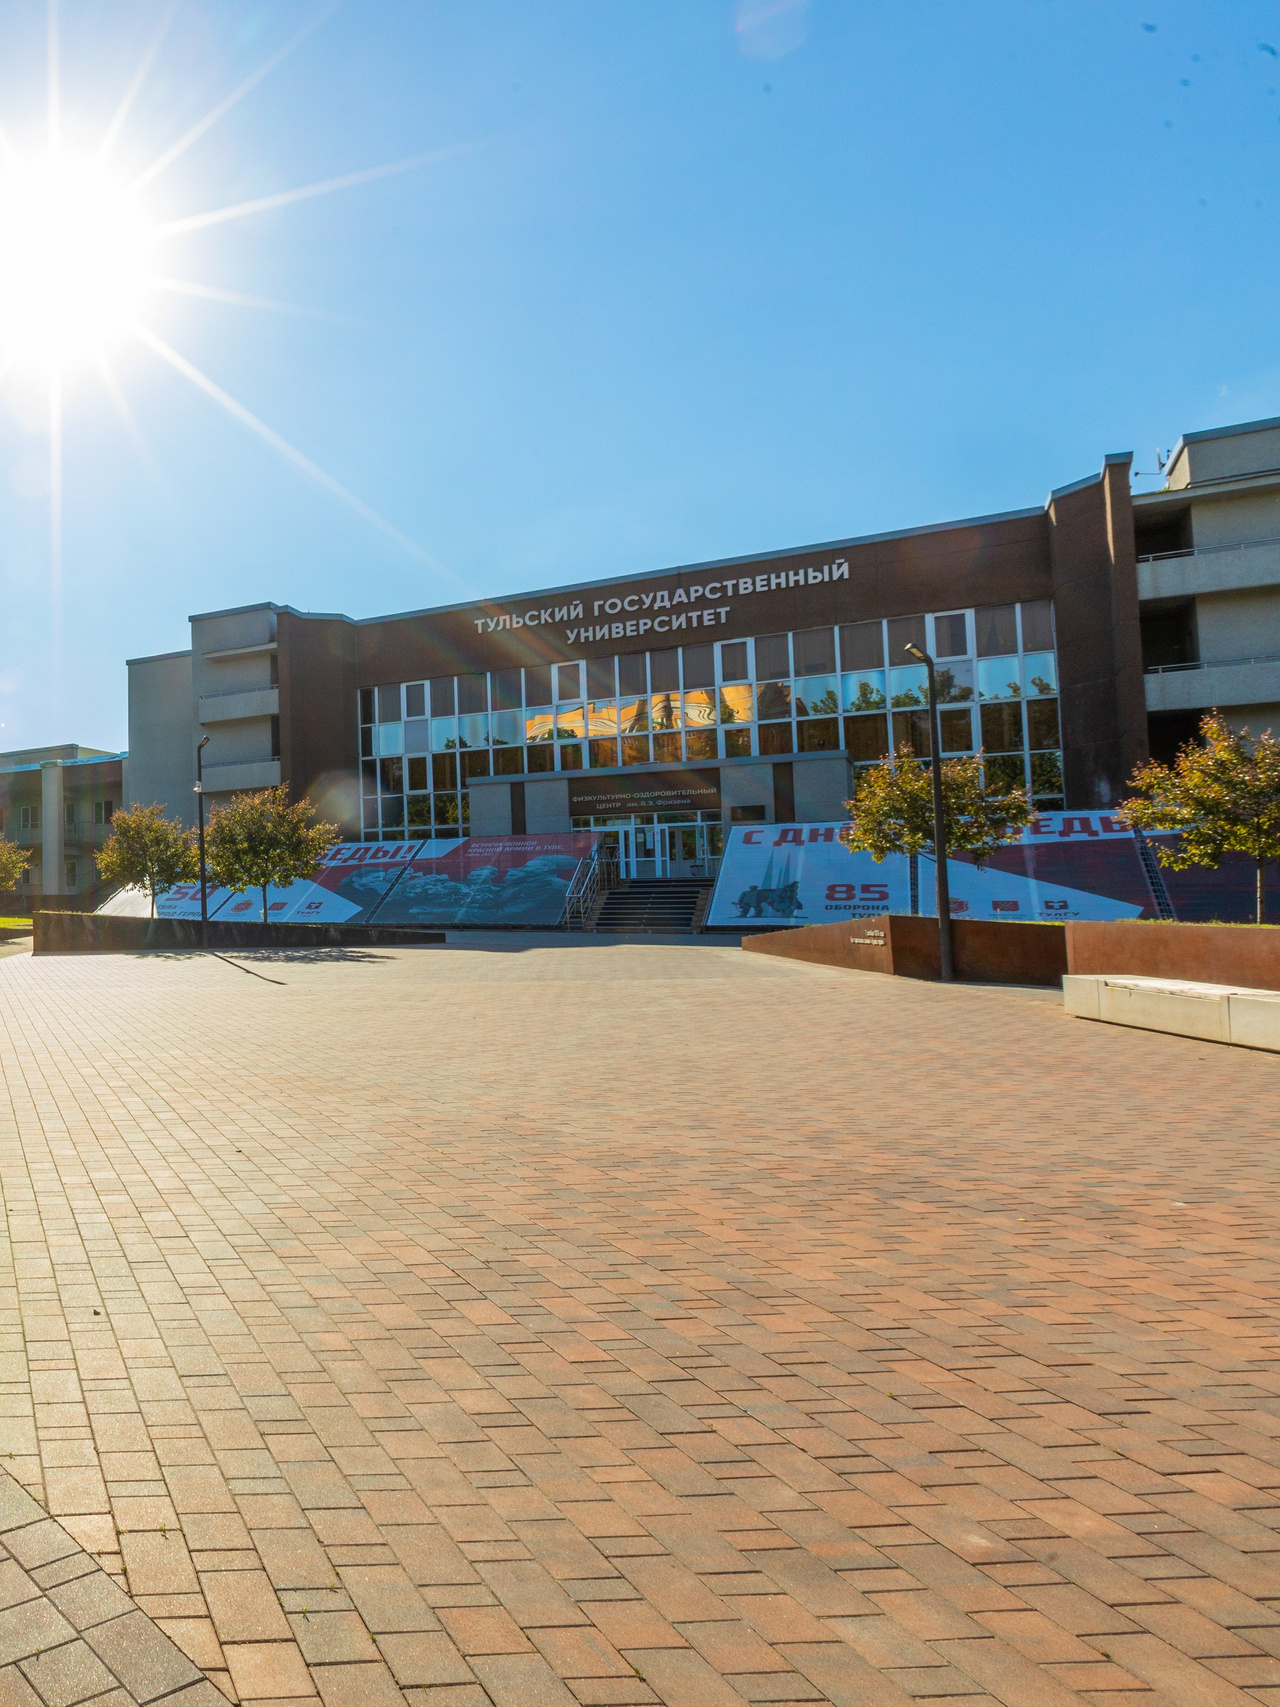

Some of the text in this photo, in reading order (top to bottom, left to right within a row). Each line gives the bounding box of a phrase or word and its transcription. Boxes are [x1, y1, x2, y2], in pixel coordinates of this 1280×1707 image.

[474, 559, 850, 635] ТУЛЬСКИЙ ГОСУДАРСТВЕННЫЙ
[565, 606, 731, 645] УНИВЕРСИТЕТ
[571, 786, 718, 802] ФИЗКУЛЬТУРНО-ОЗДОРОВИТЕЛЬНЫЙ
[596, 802, 622, 810] ЦЕНТР
[656, 798, 691, 807] Фризена
[742, 829, 765, 845] С
[825, 884, 890, 902] 85
